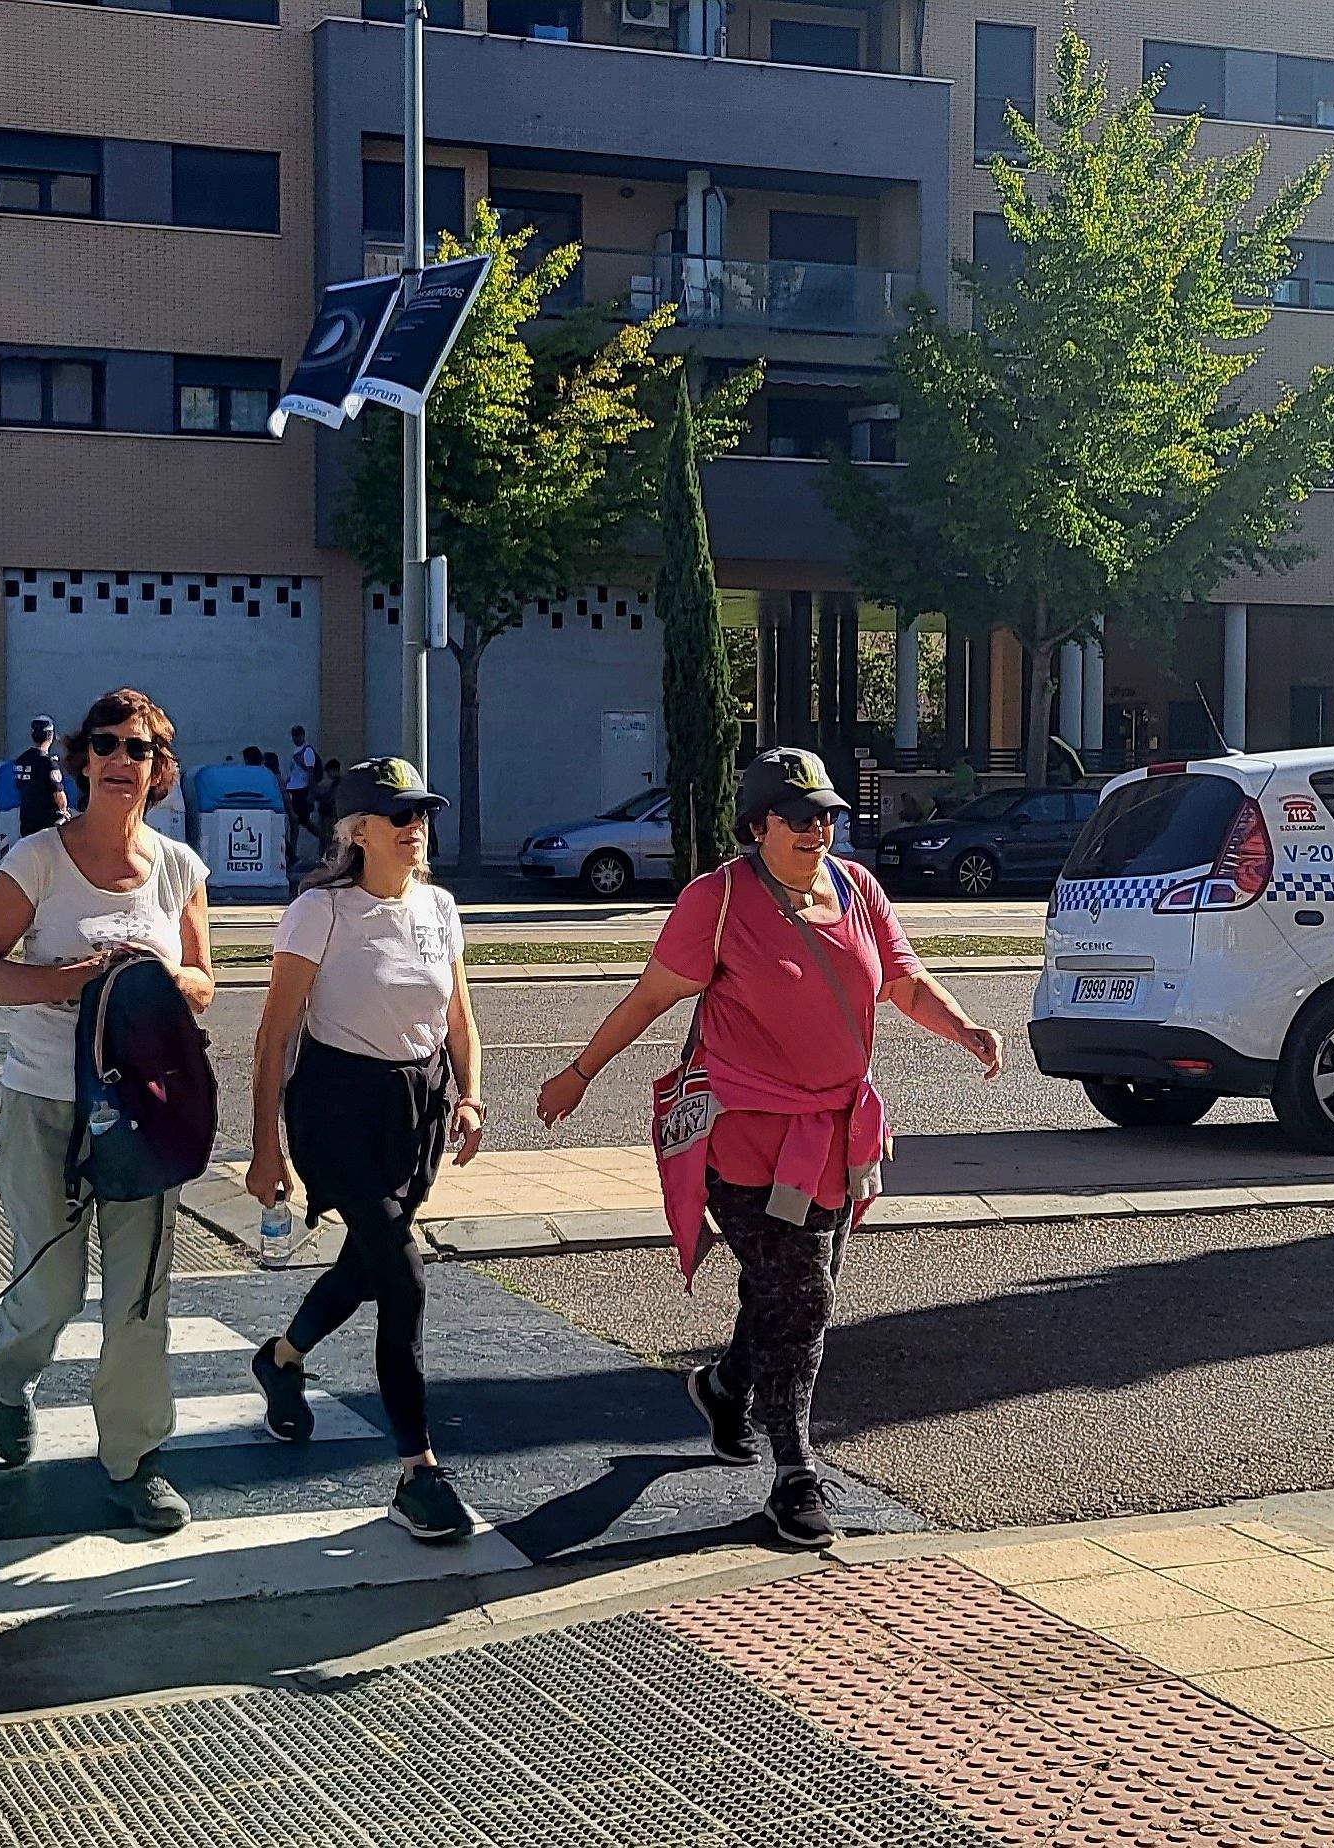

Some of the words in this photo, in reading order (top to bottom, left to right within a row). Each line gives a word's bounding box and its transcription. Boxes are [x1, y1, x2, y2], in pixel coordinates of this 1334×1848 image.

[1290, 808, 1311, 821] 112
[1283, 844, 1334, 863] V-20
[227, 861, 264, 872] RESTO
[1075, 941, 1114, 951] SCENIC
[1079, 980, 1107, 1000] 7999
[1108, 980, 1135, 1001] HBB
